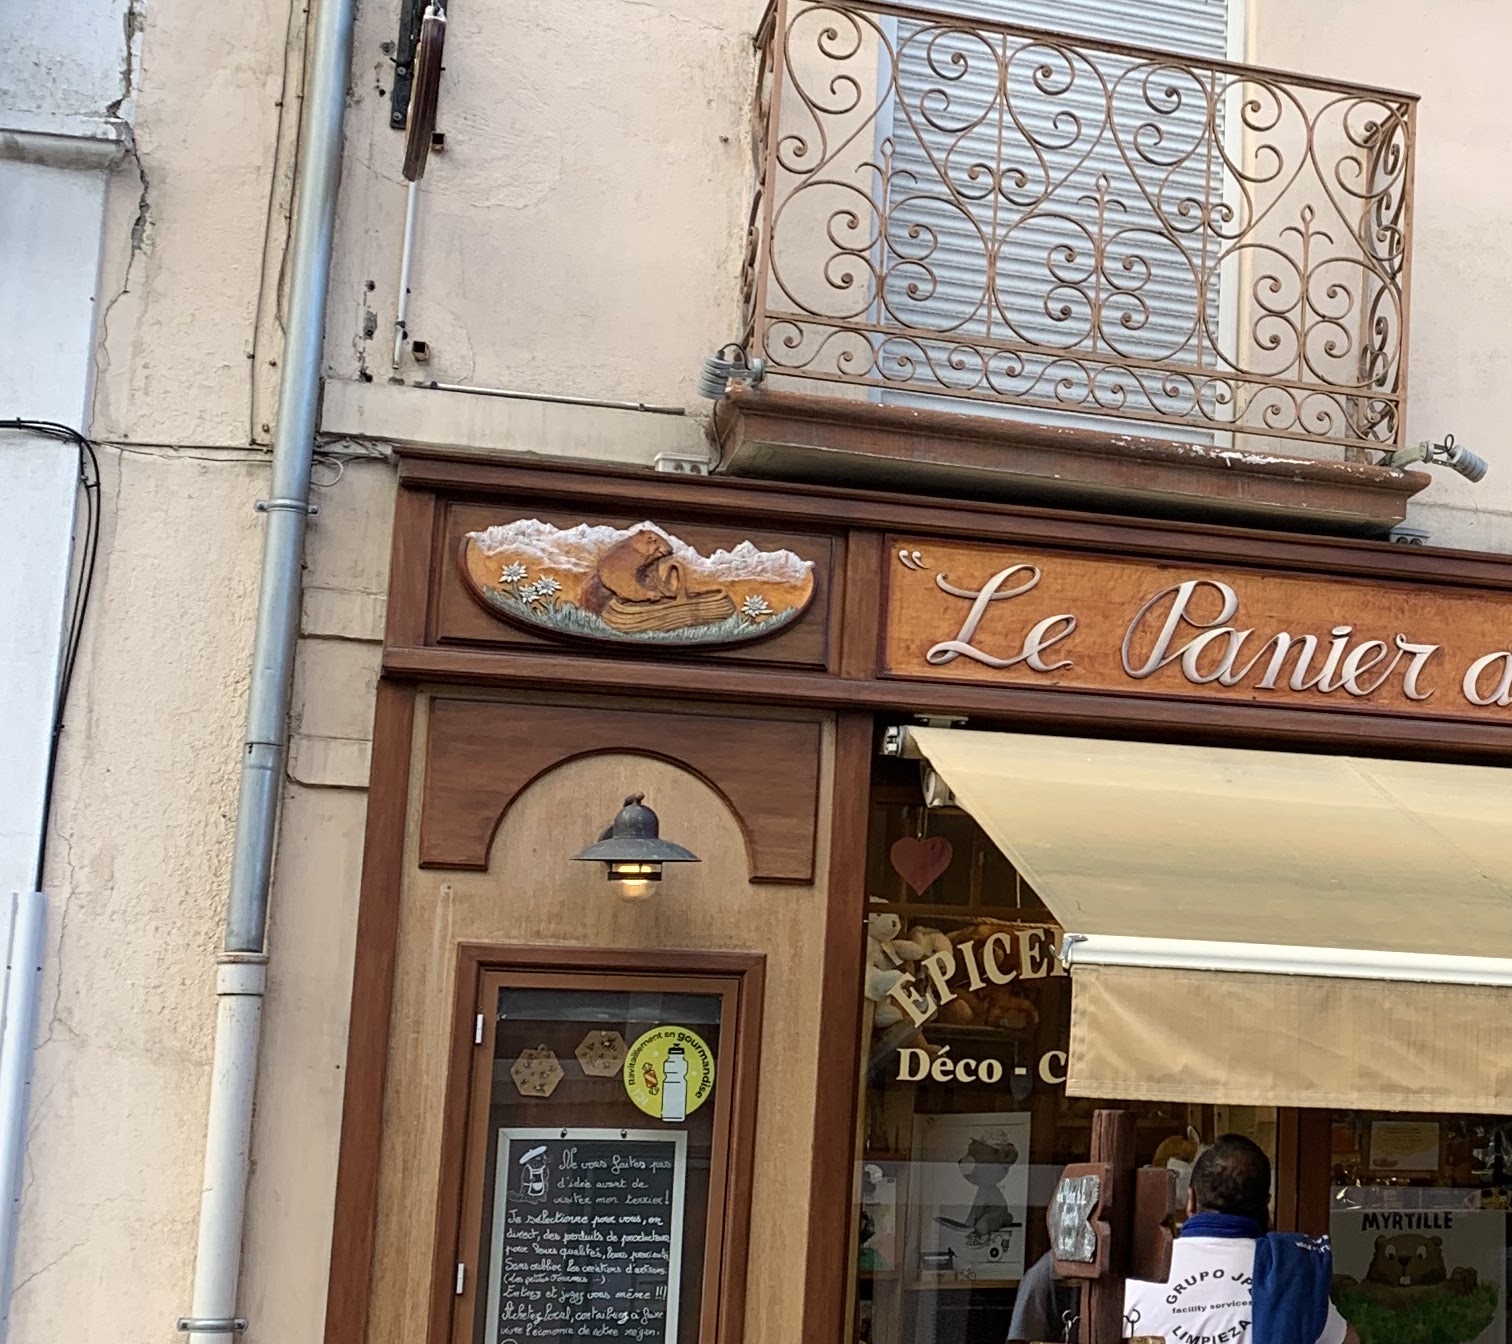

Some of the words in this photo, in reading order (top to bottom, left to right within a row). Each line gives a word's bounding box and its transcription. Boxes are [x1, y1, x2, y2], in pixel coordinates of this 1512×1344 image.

[1121, 579, 1440, 700] Panier
[664, 1031, 676, 1039] en
[677, 1032, 712, 1099] gourmandise
[896, 1045, 1003, 1084] Déco
[1361, 1211, 1454, 1231] MYRTILLE
[1166, 1268, 1225, 1305] GRUPO
[1231, 1272, 1253, 1297] JP
[1171, 1304, 1207, 1315] facility
